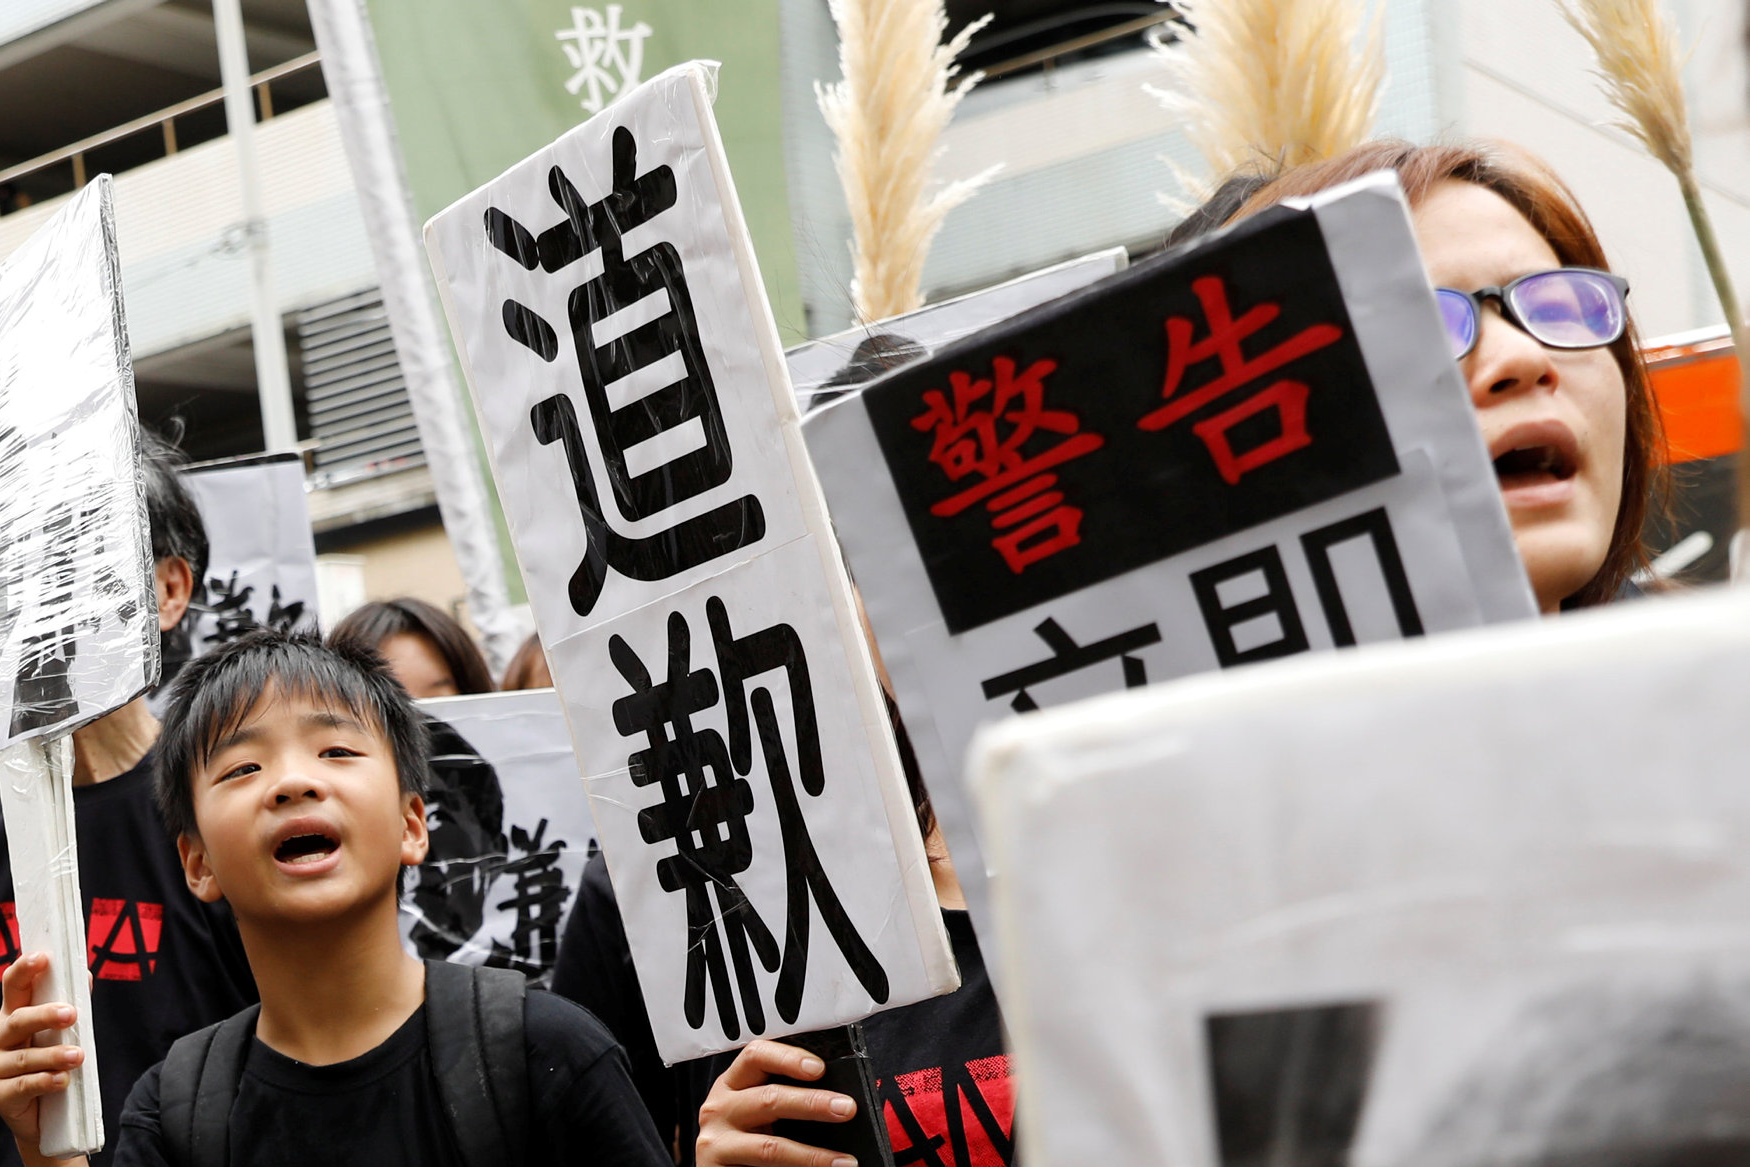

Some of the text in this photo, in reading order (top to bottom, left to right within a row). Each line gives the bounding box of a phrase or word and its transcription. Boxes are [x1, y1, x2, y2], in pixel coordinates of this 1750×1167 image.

[554, 4, 653, 114] 救
[910, 275, 1343, 574] 警告
[483, 125, 890, 1041] 道歉
